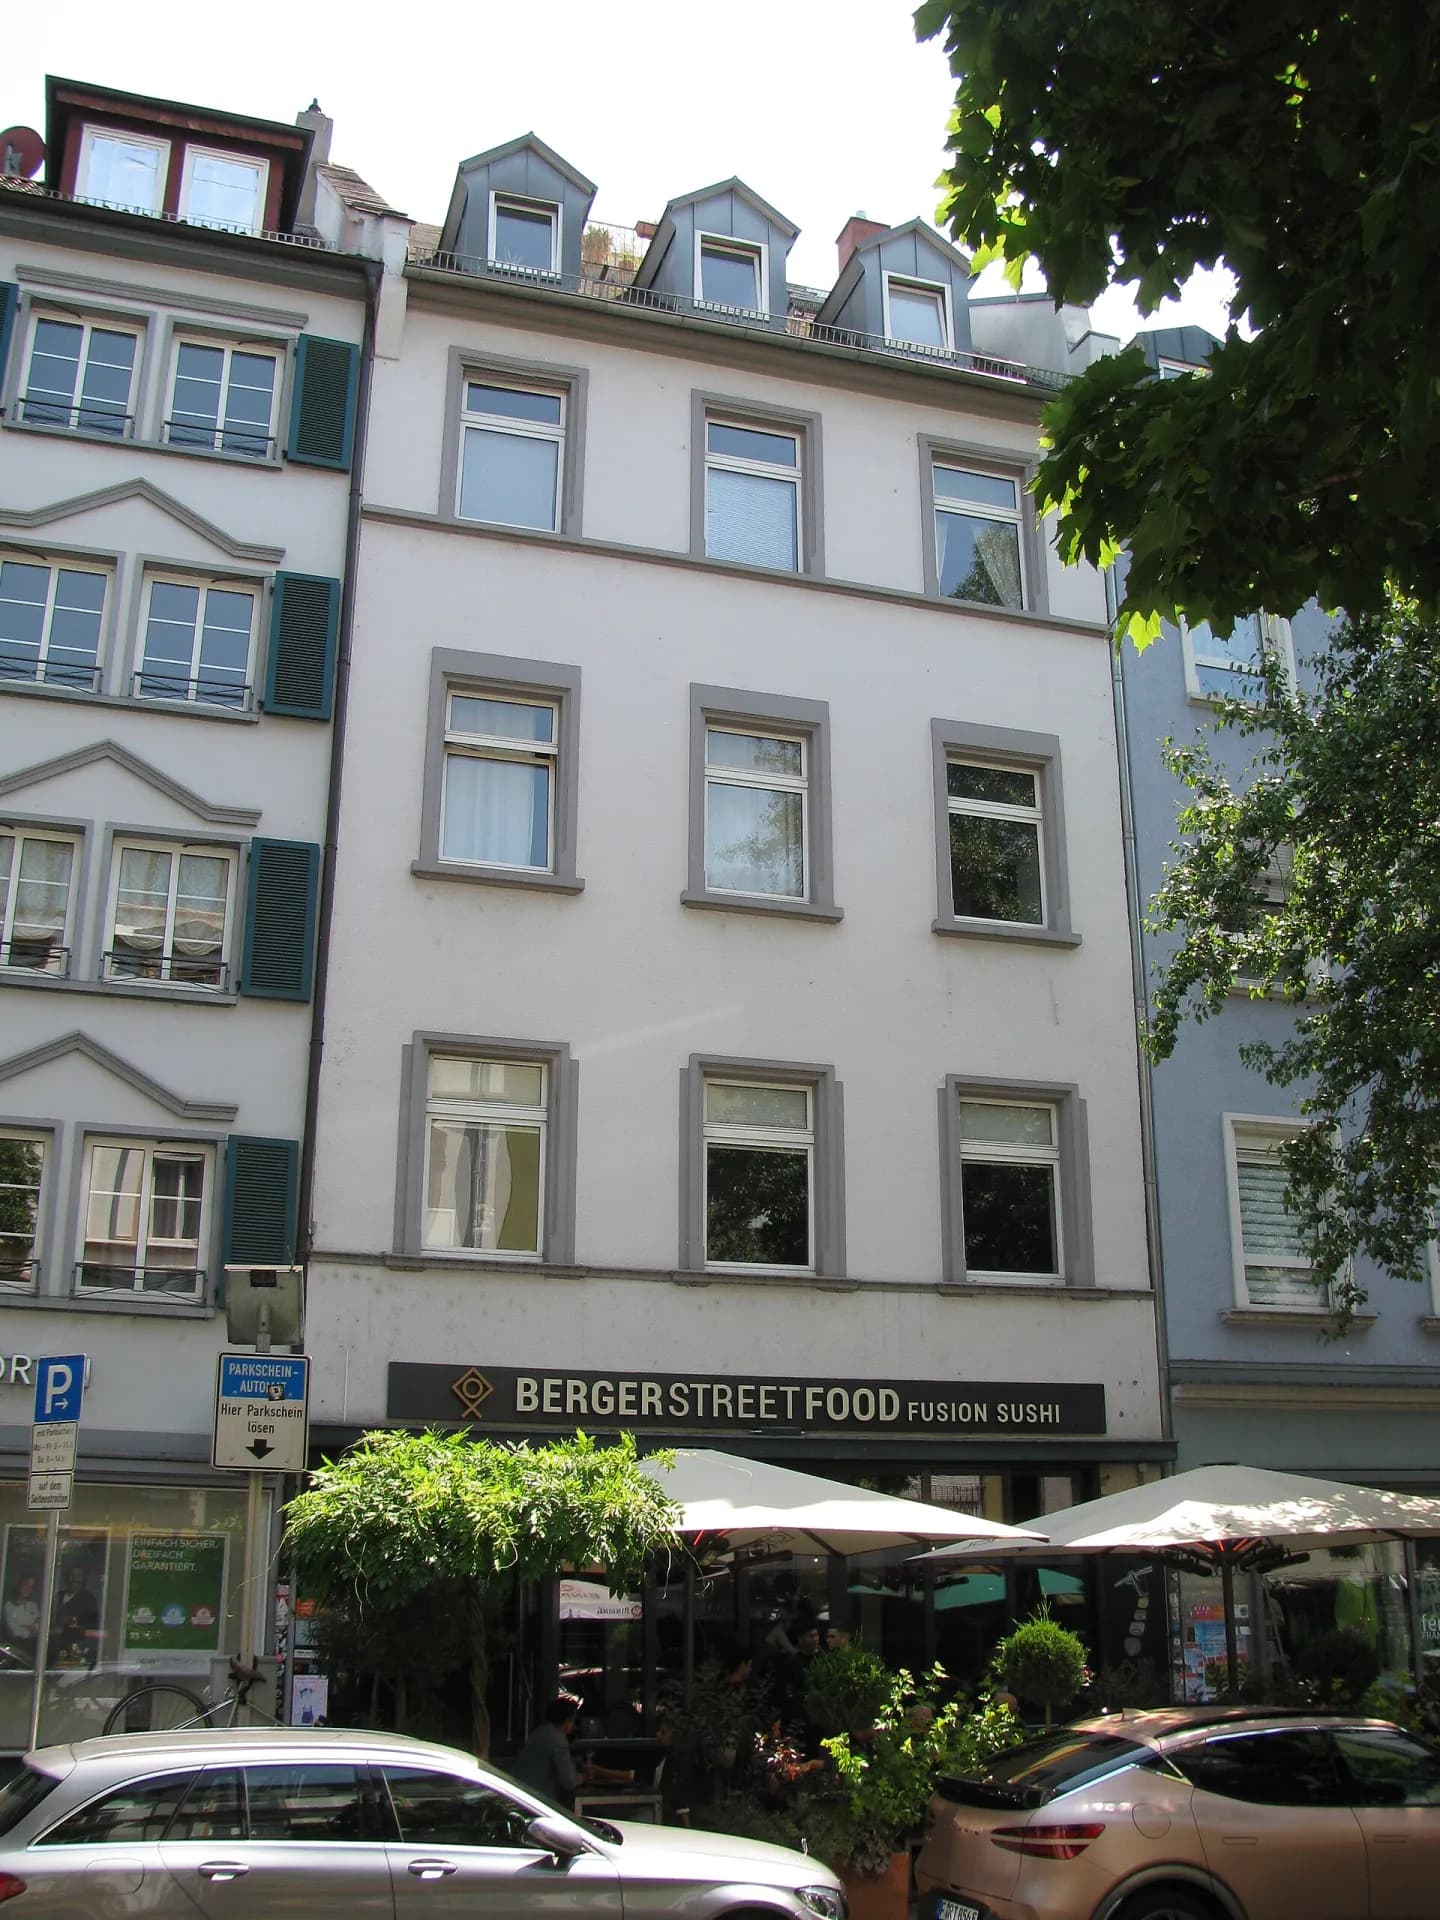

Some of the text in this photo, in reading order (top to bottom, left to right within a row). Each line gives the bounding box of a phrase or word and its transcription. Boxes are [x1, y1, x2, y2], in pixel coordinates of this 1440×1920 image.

[228, 1362, 300, 1378] PARKSCHEIN-
[45, 1364, 73, 1414] P
[221, 1403, 303, 1419] Hier Parkschein
[908, 1402, 988, 1422] FUSION
[997, 1403, 1061, 1424] SUSHI
[247, 1420, 275, 1434] lösen
